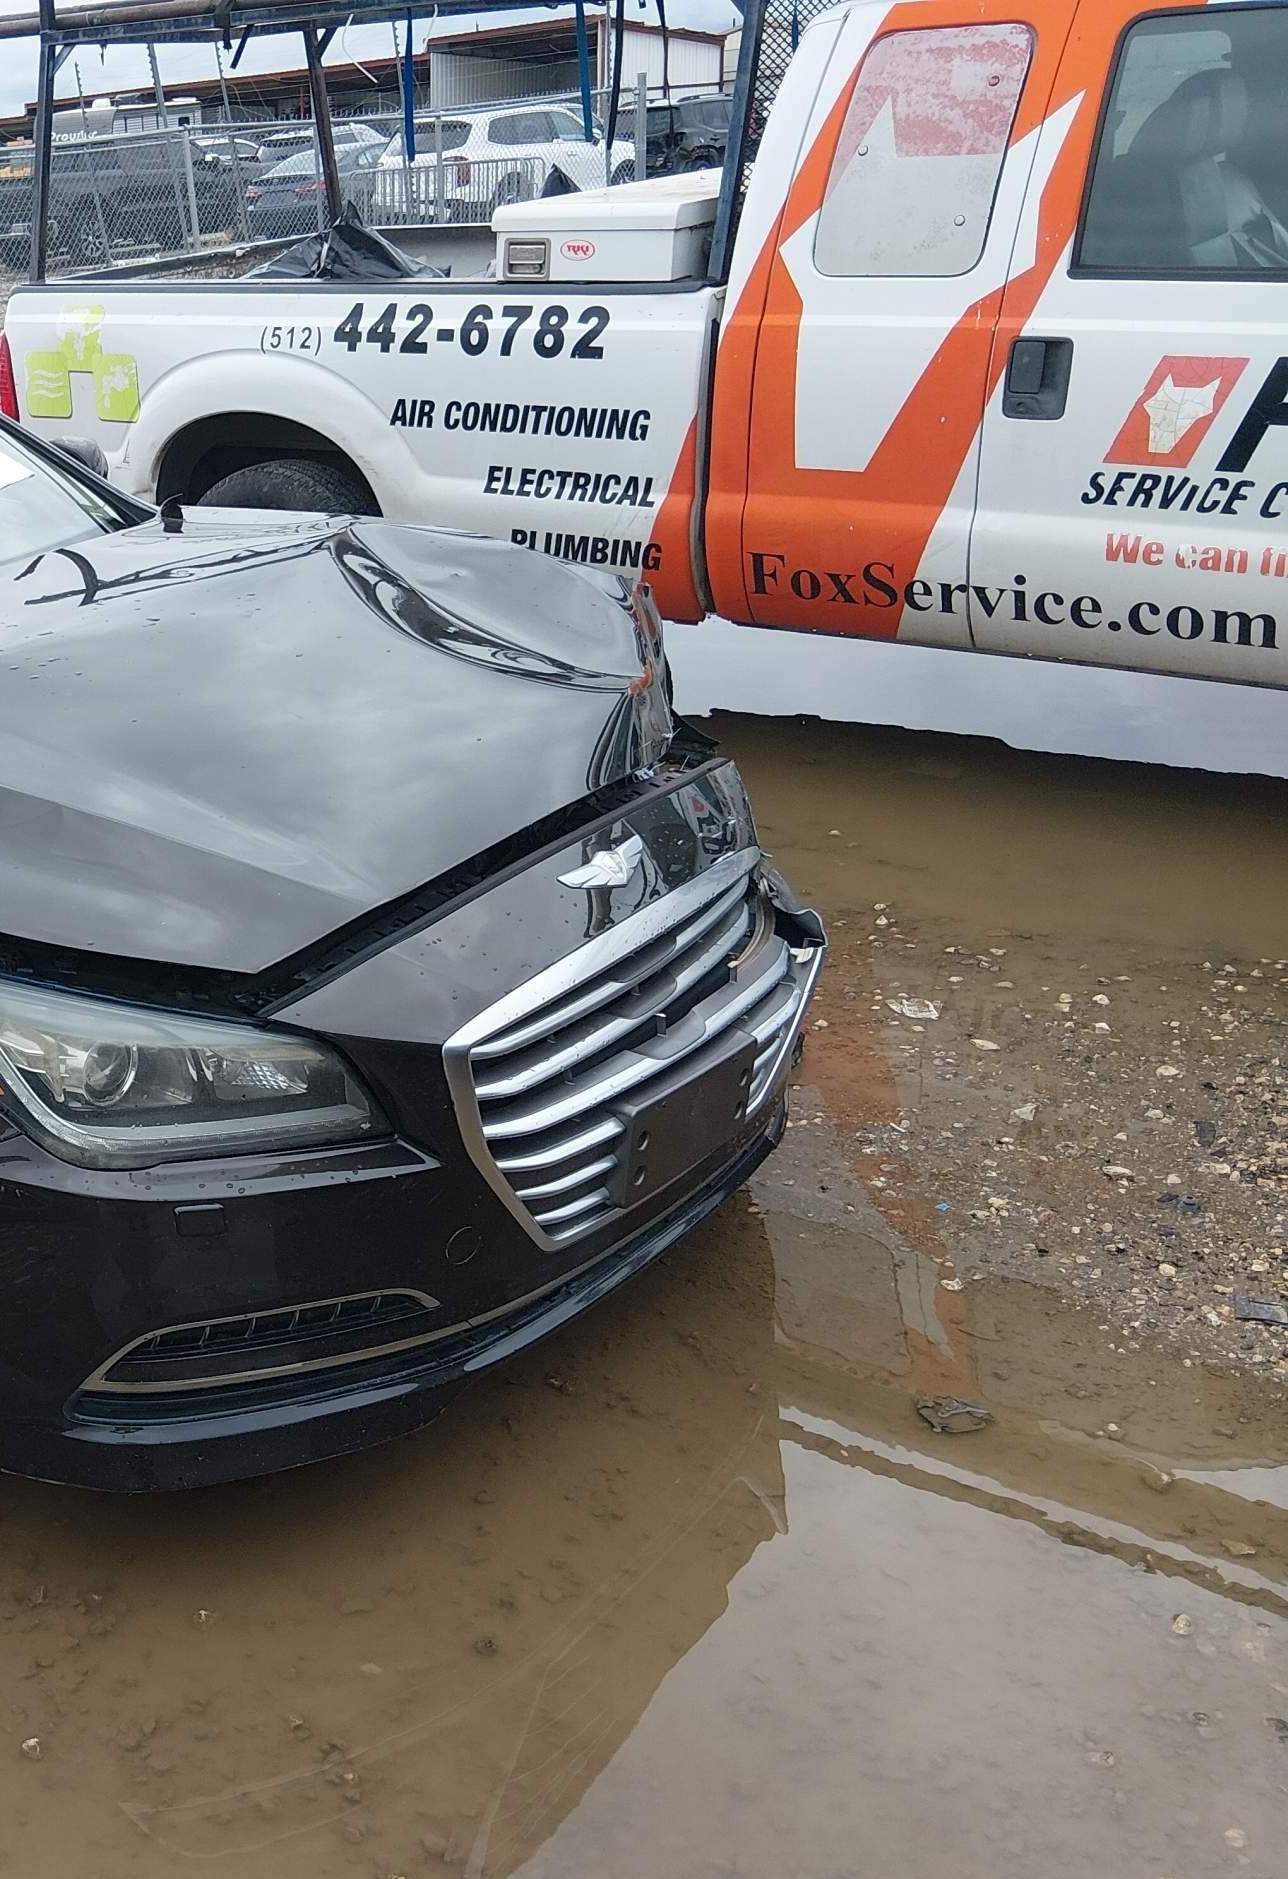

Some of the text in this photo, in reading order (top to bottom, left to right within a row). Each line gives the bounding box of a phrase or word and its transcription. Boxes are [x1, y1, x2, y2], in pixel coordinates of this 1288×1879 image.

[260, 302, 611, 360] (512) 442-6782
[390, 398, 651, 442] AIR CONDITIONING
[483, 465, 656, 508] ELECTRICAL
[1080, 471, 1255, 515] SERVICE
[510, 528, 663, 571] PLUMBING
[1105, 532, 1165, 567] We
[1174, 544, 1249, 574] can
[746, 551, 1281, 651] FoxService.com
